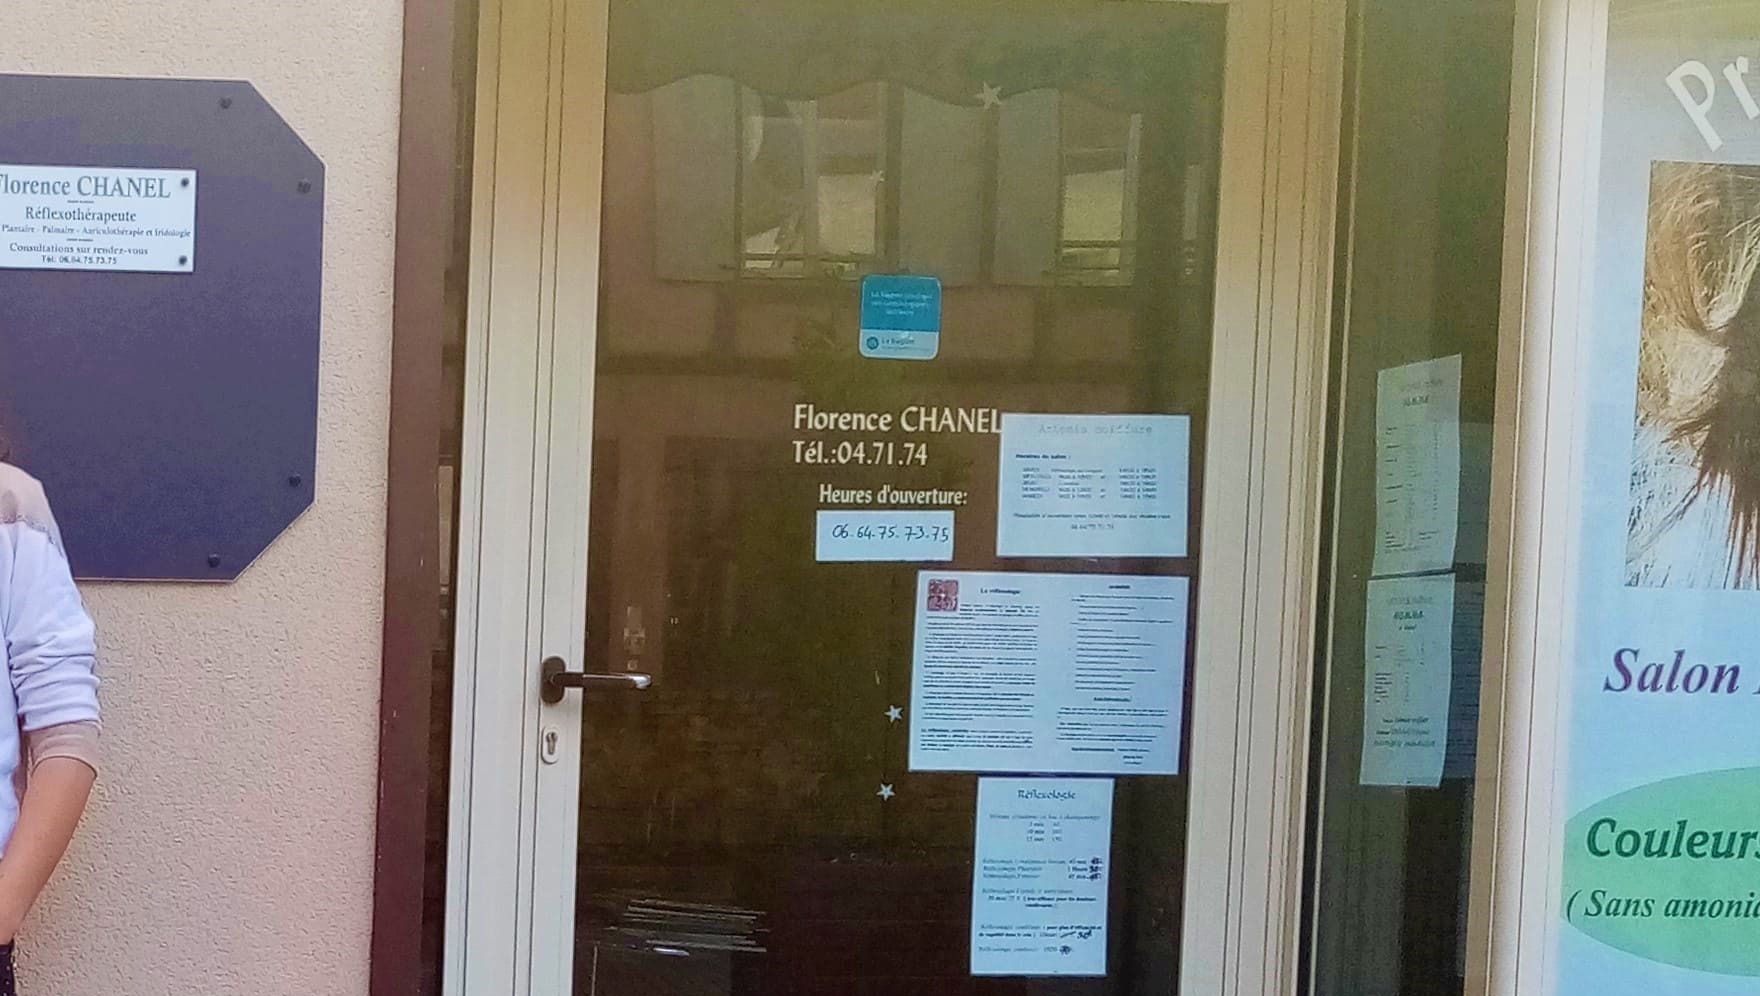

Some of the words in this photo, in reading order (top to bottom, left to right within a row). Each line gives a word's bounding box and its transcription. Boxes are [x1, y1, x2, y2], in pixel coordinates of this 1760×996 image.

[77, 175, 171, 198] CHANEL
[25, 206, 137, 224] Réflexothérapeute
[9, 242, 75, 254] Consultations
[77, 246, 90, 254] sur
[93, 245, 148, 255] rendez-vous
[794, 404, 892, 431] Florence
[900, 406, 1002, 433] CHANEL
[819, 484, 872, 504] Heures
[877, 484, 968, 505] d'ouverture:
[1604, 648, 1740, 694] Salon
